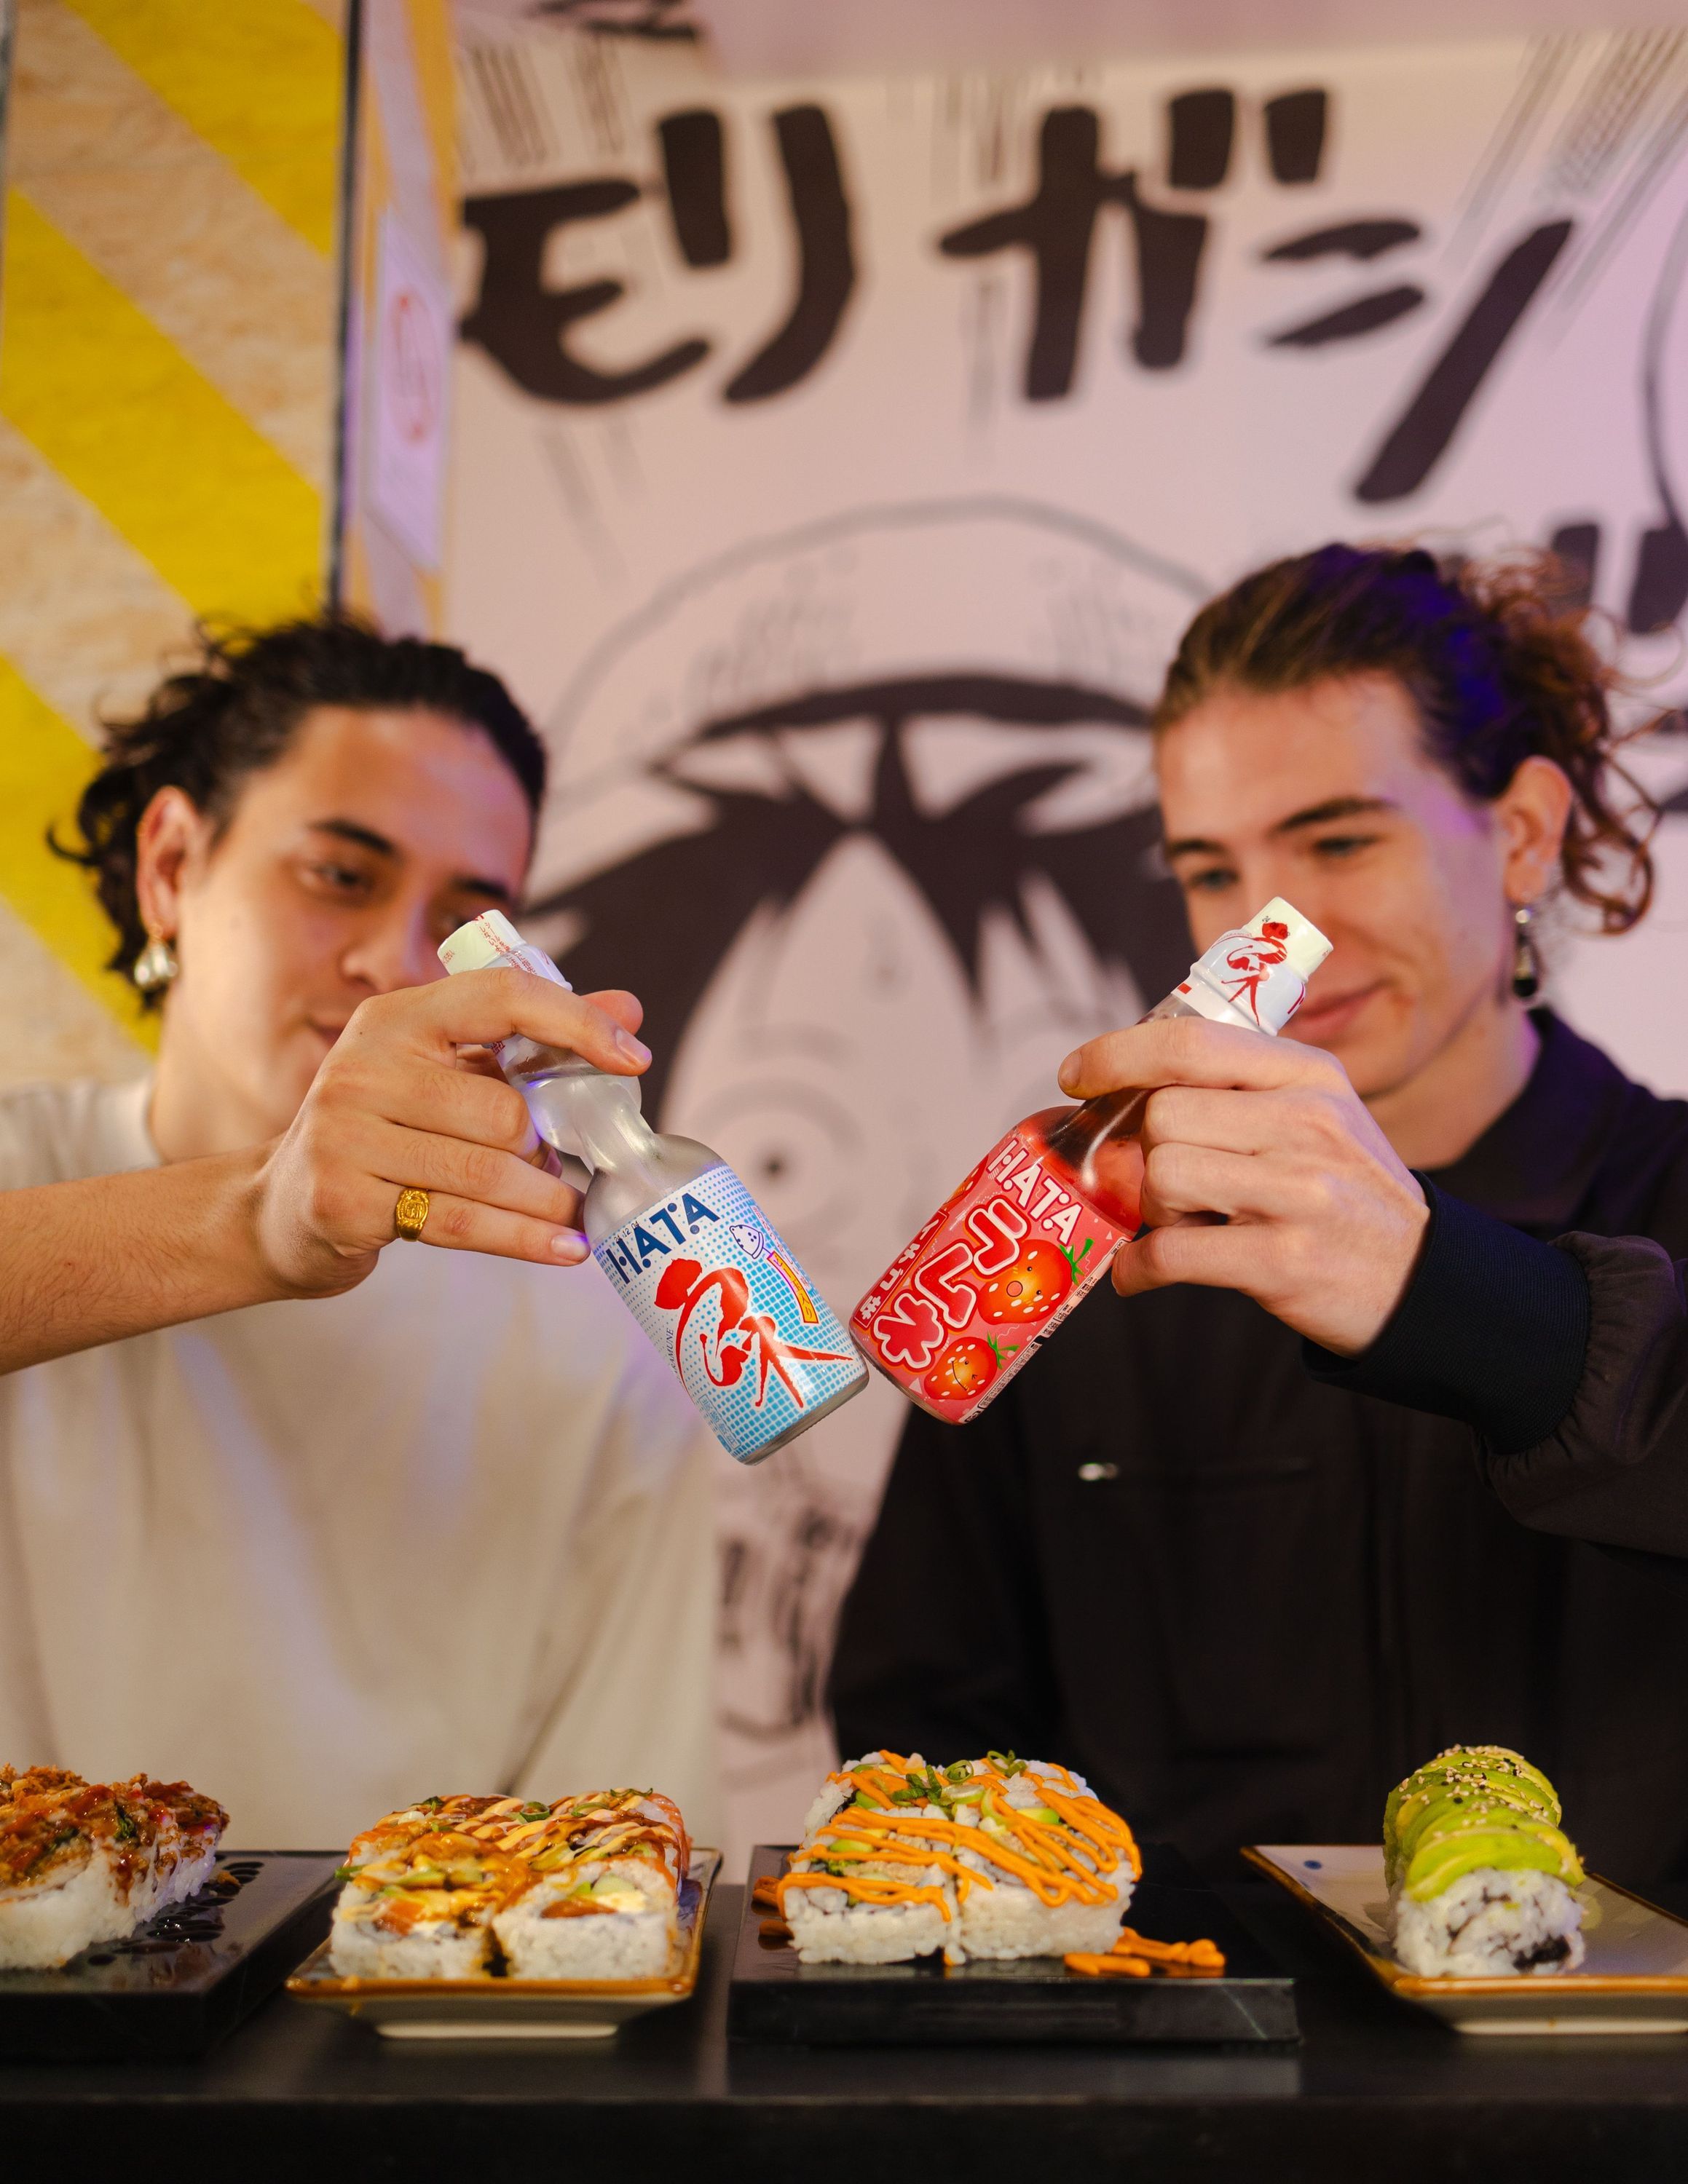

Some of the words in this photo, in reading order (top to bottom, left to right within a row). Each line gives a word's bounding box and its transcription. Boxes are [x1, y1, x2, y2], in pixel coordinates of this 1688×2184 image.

[606, 1192, 719, 1284] HATA
[986, 1137, 1083, 1245] HATA
[773, 1253, 813, 1320] ビー玉入り
[859, 1219, 939, 1319] イチゴ味
[873, 1198, 1028, 1369] ラムネ
